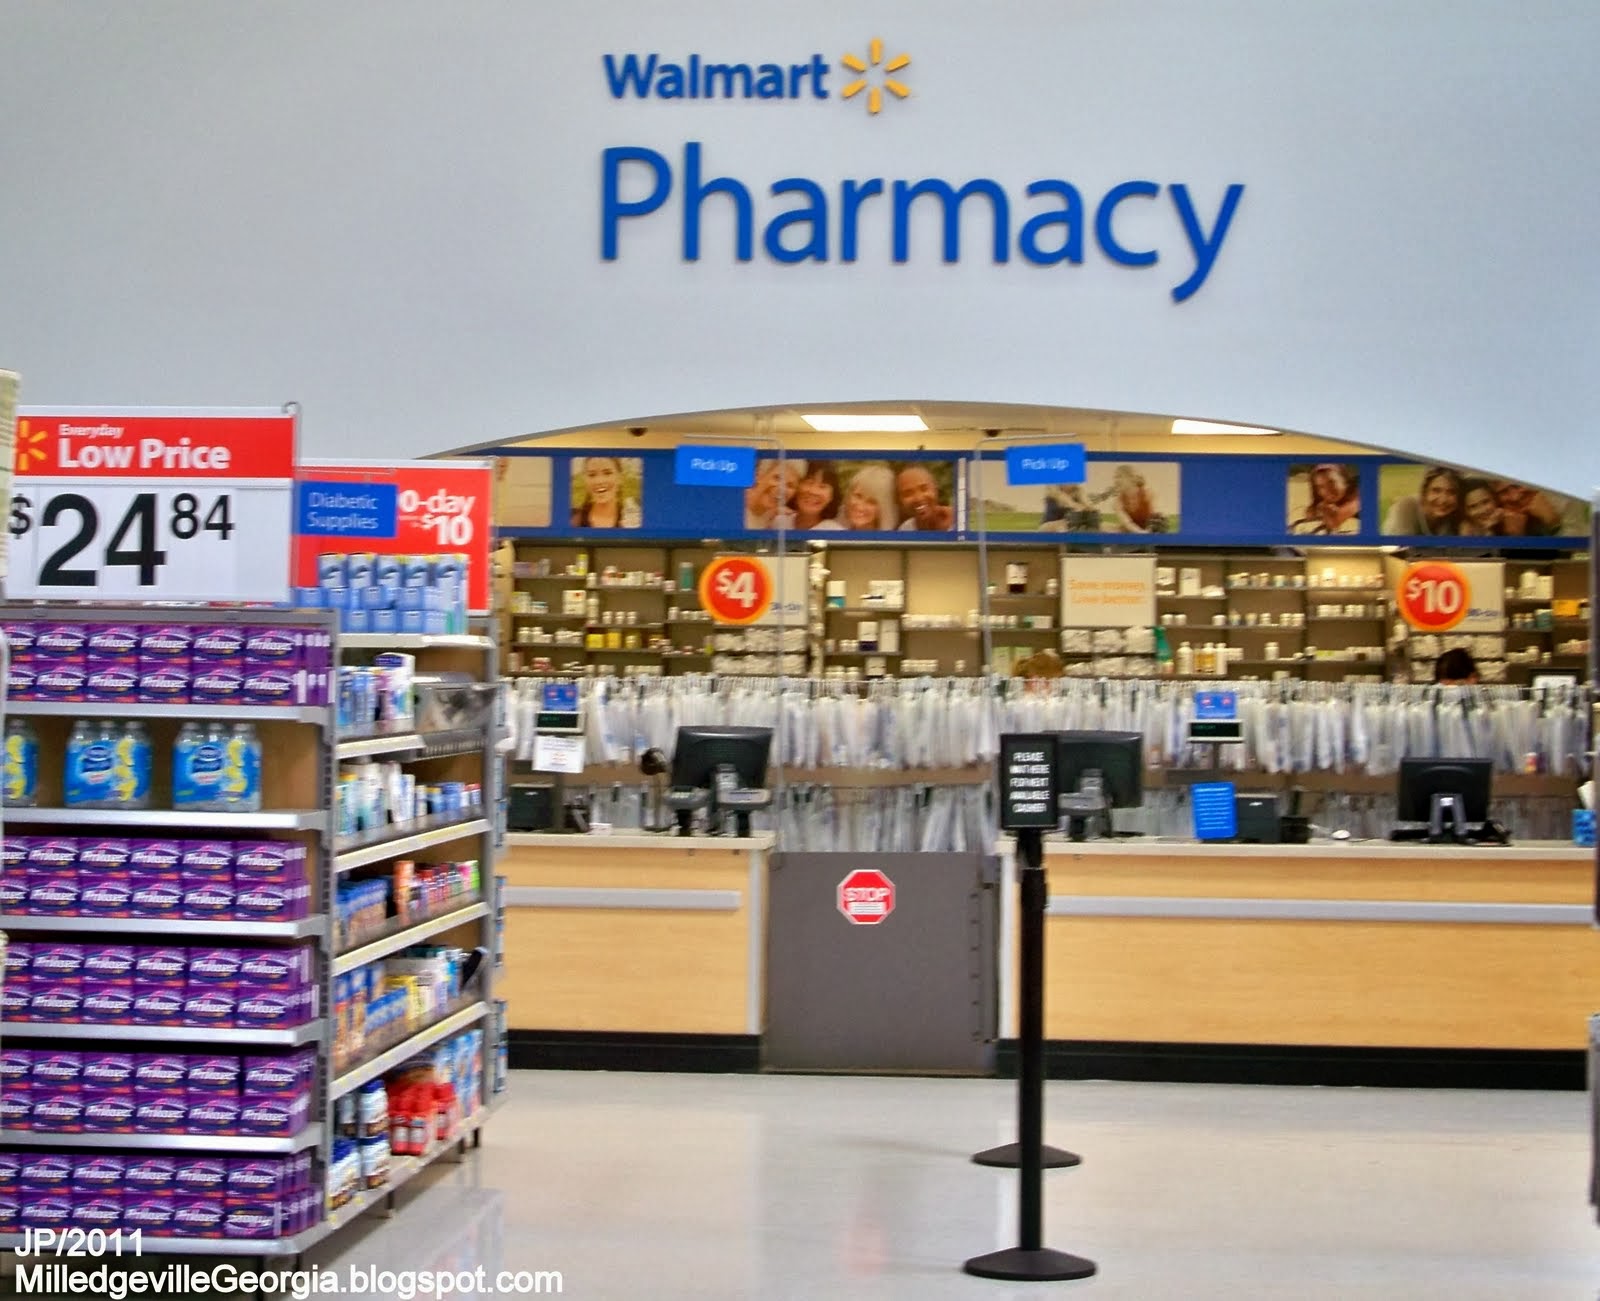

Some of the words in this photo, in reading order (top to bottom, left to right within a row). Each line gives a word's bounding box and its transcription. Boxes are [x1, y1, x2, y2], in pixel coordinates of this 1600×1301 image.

[603, 54, 830, 99] Walmart
[601, 141, 1246, 303] Pharmacy
[58, 424, 124, 439] Everyday
[58, 438, 135, 468] Low
[139, 437, 231, 469] Price
[308, 491, 379, 510] Diabetic
[399, 488, 476, 518] 0-day
[307, 511, 379, 531] Supplies
[421, 513, 474, 546] $10
[715, 567, 758, 609] $4
[1405, 577, 1462, 614] $10
[843, 887, 891, 902] STOP
